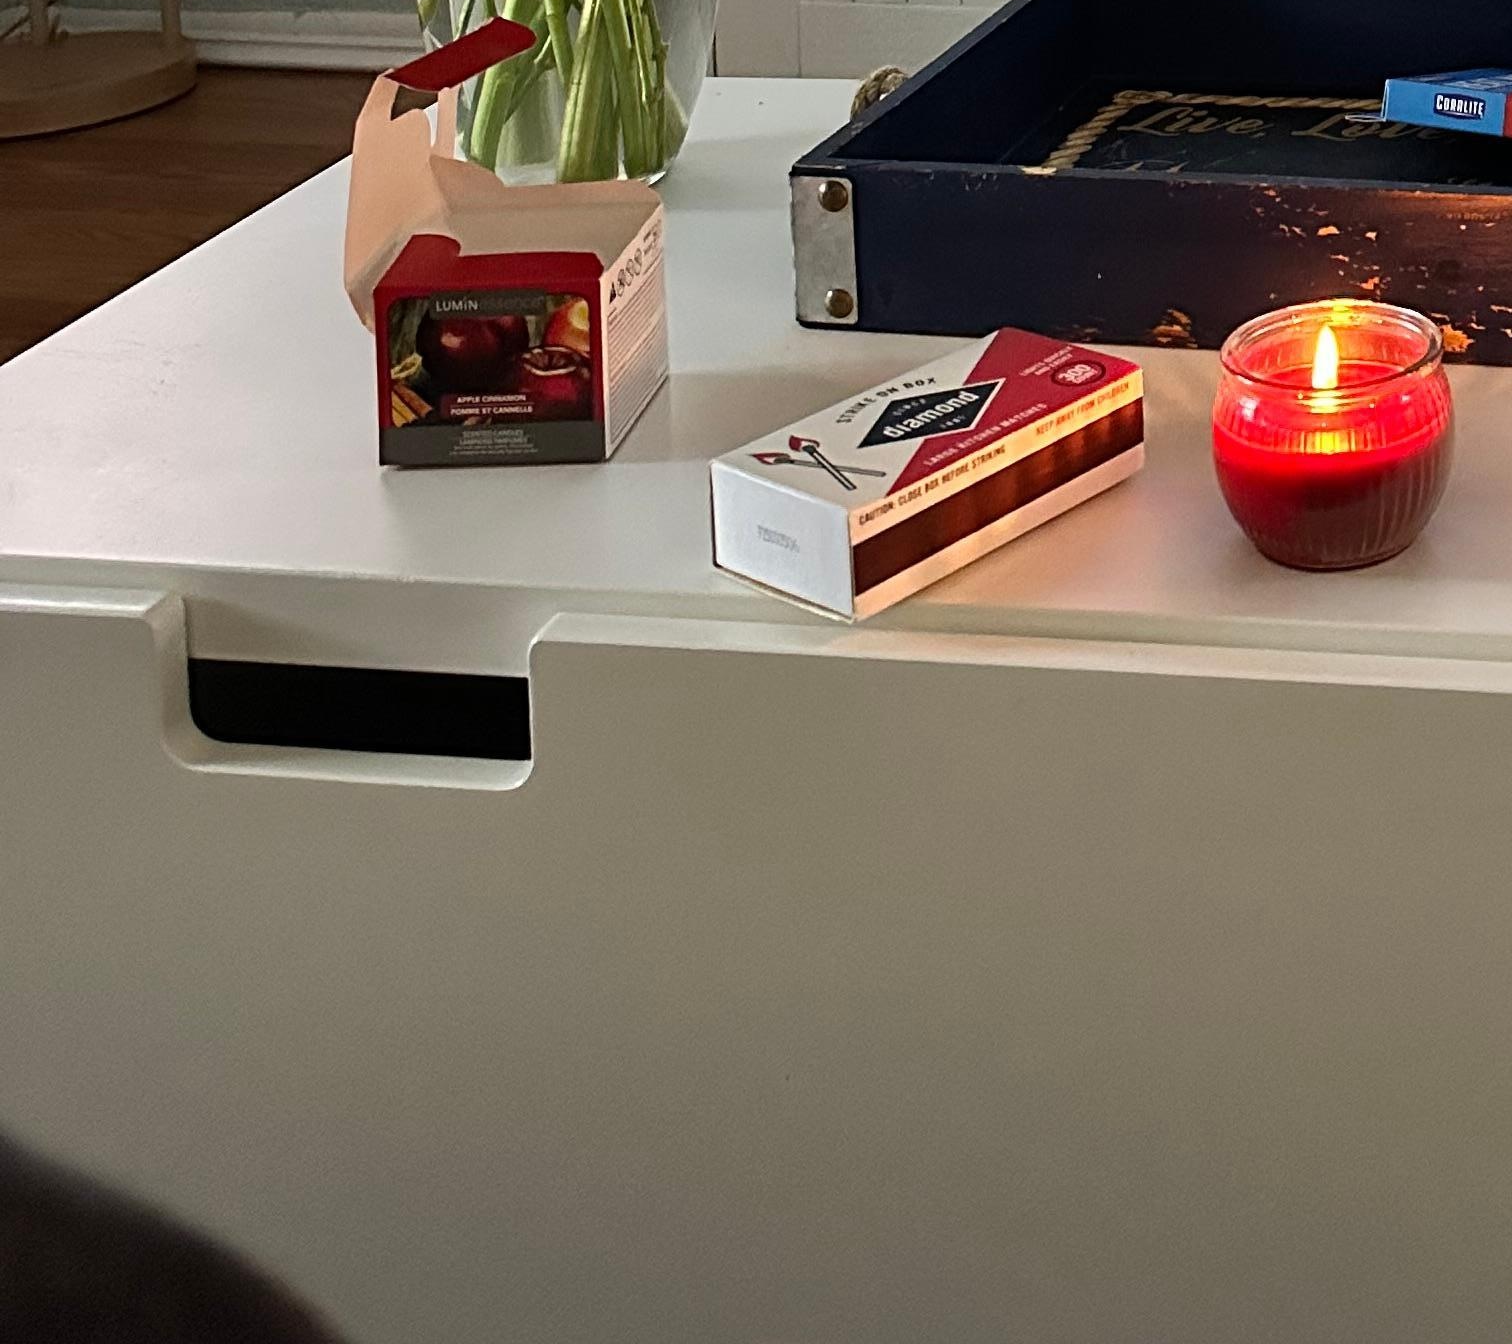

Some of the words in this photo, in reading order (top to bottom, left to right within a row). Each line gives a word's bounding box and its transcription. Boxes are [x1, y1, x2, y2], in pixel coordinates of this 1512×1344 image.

[1436, 95, 1484, 118] CORALITE
[451, 407, 480, 416] POMME
[482, 407, 491, 415] ET
[493, 405, 533, 414] CANNELLE
[457, 396, 481, 404] APPLE
[482, 394, 527, 403] CINNAMON
[836, 396, 877, 424] STRIKE
[876, 386, 899, 398] ON
[902, 377, 936, 390] BOX
[883, 391, 979, 438] diamond
[1000, 403, 1047, 430] MATCHES
[898, 489, 922, 506] CLOSE
[925, 478, 939, 493] BOX
[942, 466, 969, 486] BEFORE
[971, 445, 1006, 469] STRIKING
